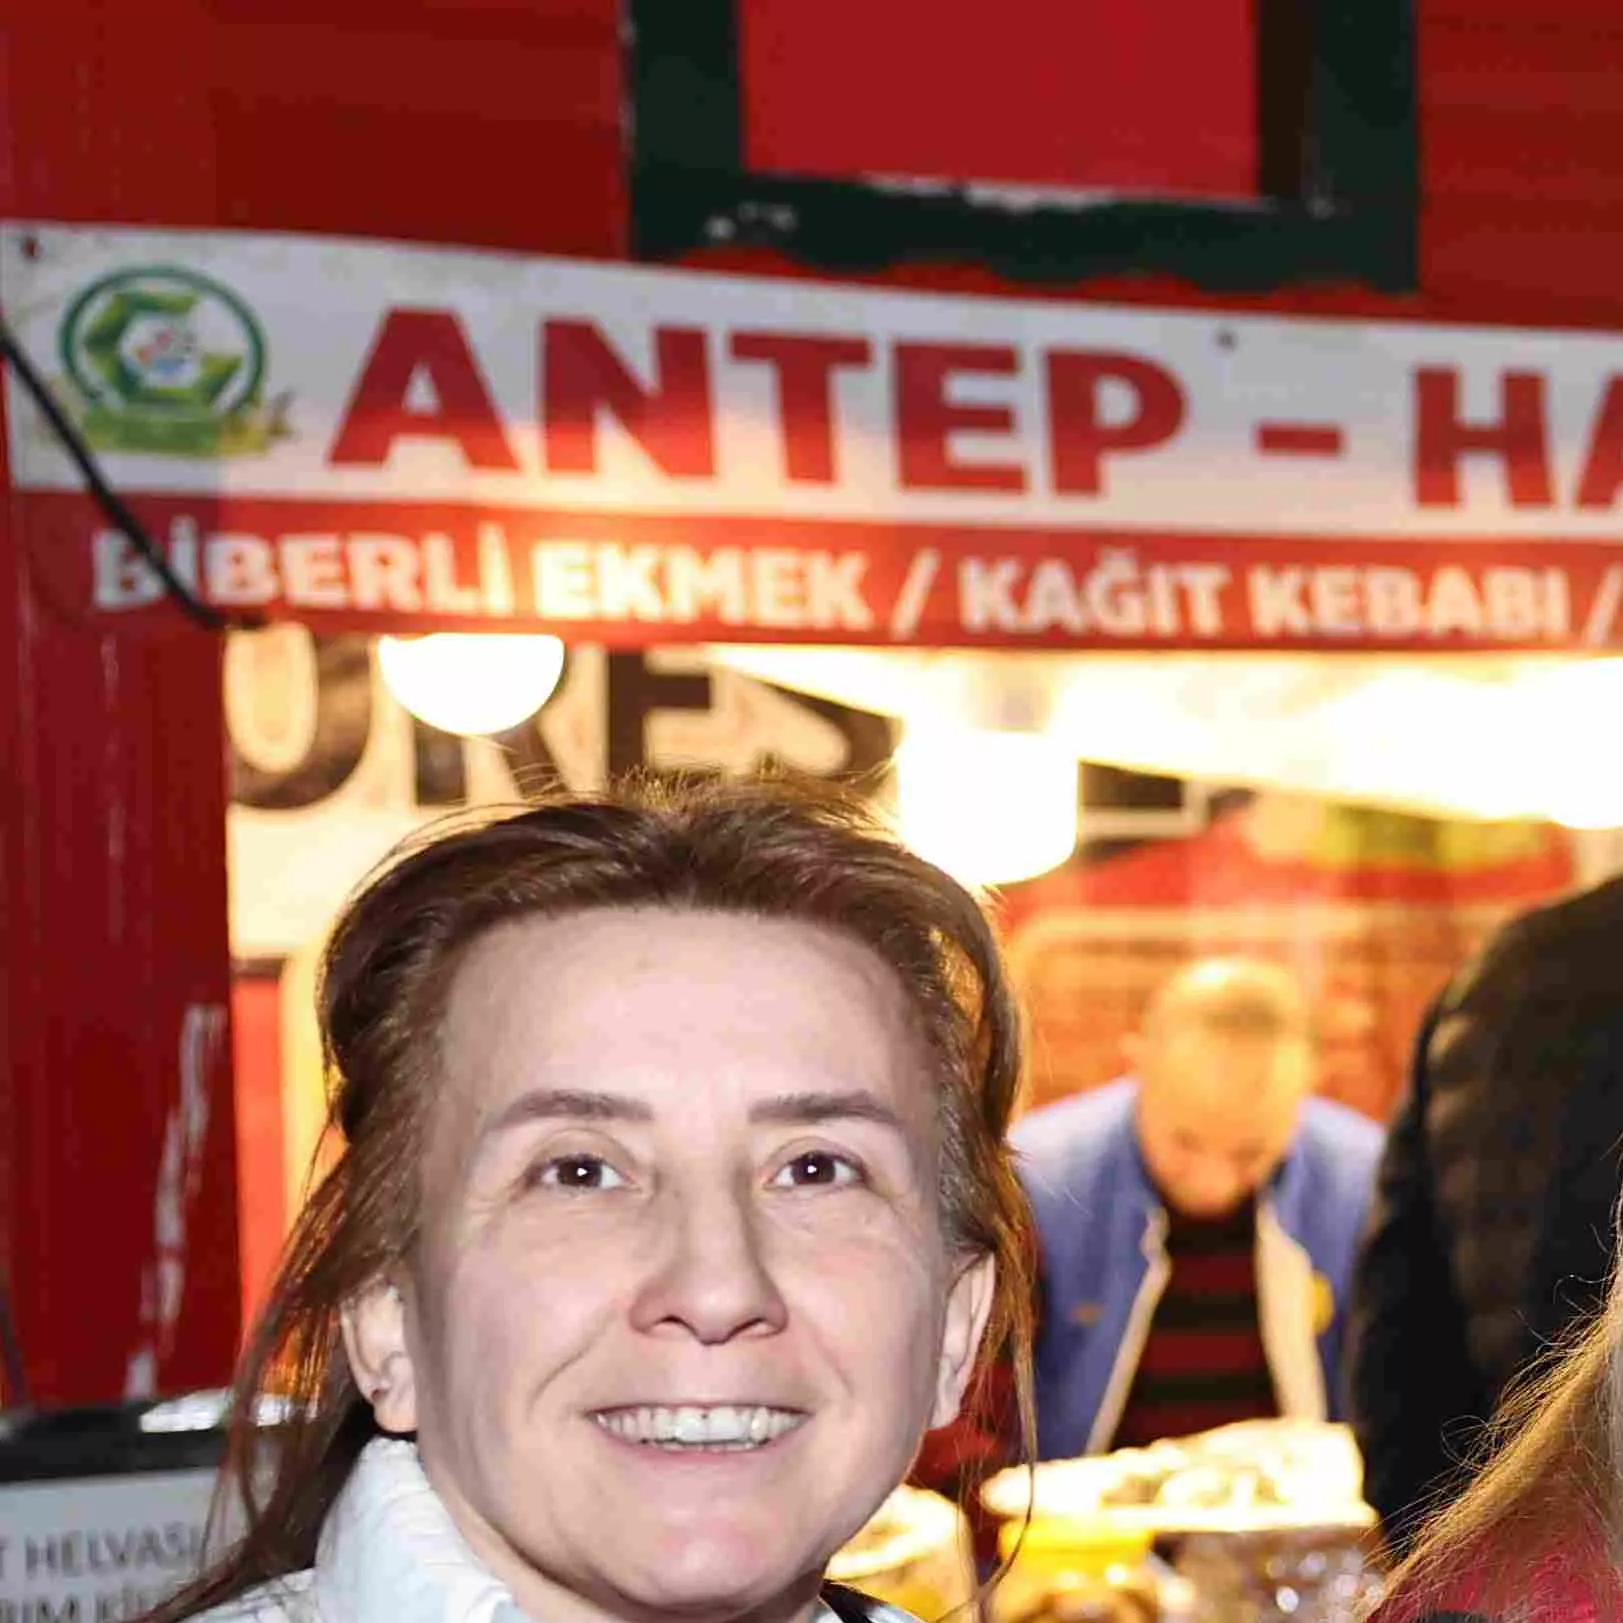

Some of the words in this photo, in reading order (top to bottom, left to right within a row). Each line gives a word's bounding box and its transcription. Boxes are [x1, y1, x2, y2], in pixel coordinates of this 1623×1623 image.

[327, 307, 1188, 498] ANTEP
[1254, 422, 1346, 456] -
[92, 516, 511, 618] BİBERLİ
[532, 538, 872, 631] EKMEK
[959, 547, 1232, 637] KAĞIT
[1249, 567, 1571, 641] KEBABI
